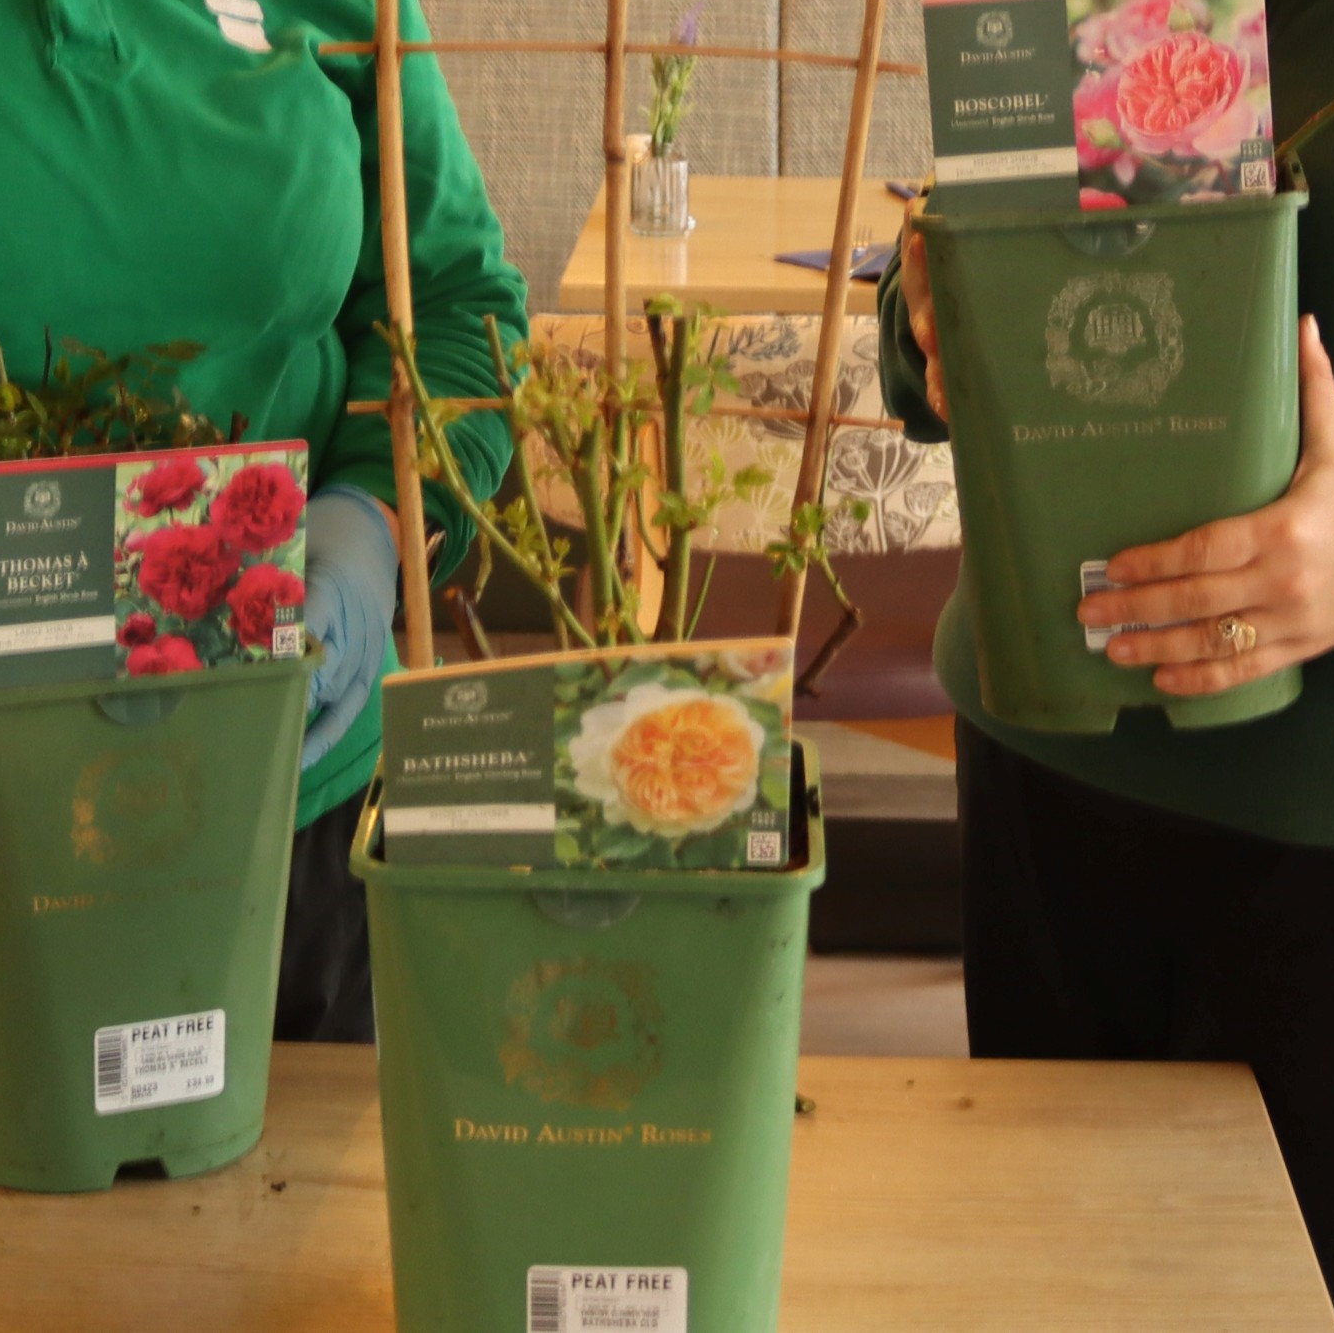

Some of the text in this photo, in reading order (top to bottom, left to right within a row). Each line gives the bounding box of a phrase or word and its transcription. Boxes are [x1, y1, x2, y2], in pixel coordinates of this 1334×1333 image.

[954, 93, 1045, 115] BOSCOBEL
[1013, 424, 1074, 442] DAVID
[1170, 416, 1228, 433] ROSES
[404, 751, 528, 772] BATHSHEBA
[132, 1016, 214, 1042] PEAT FREE
[455, 1120, 528, 1142] DAVID
[641, 1124, 712, 1144] ROSES
[571, 1273, 673, 1290] PEAT FREE
